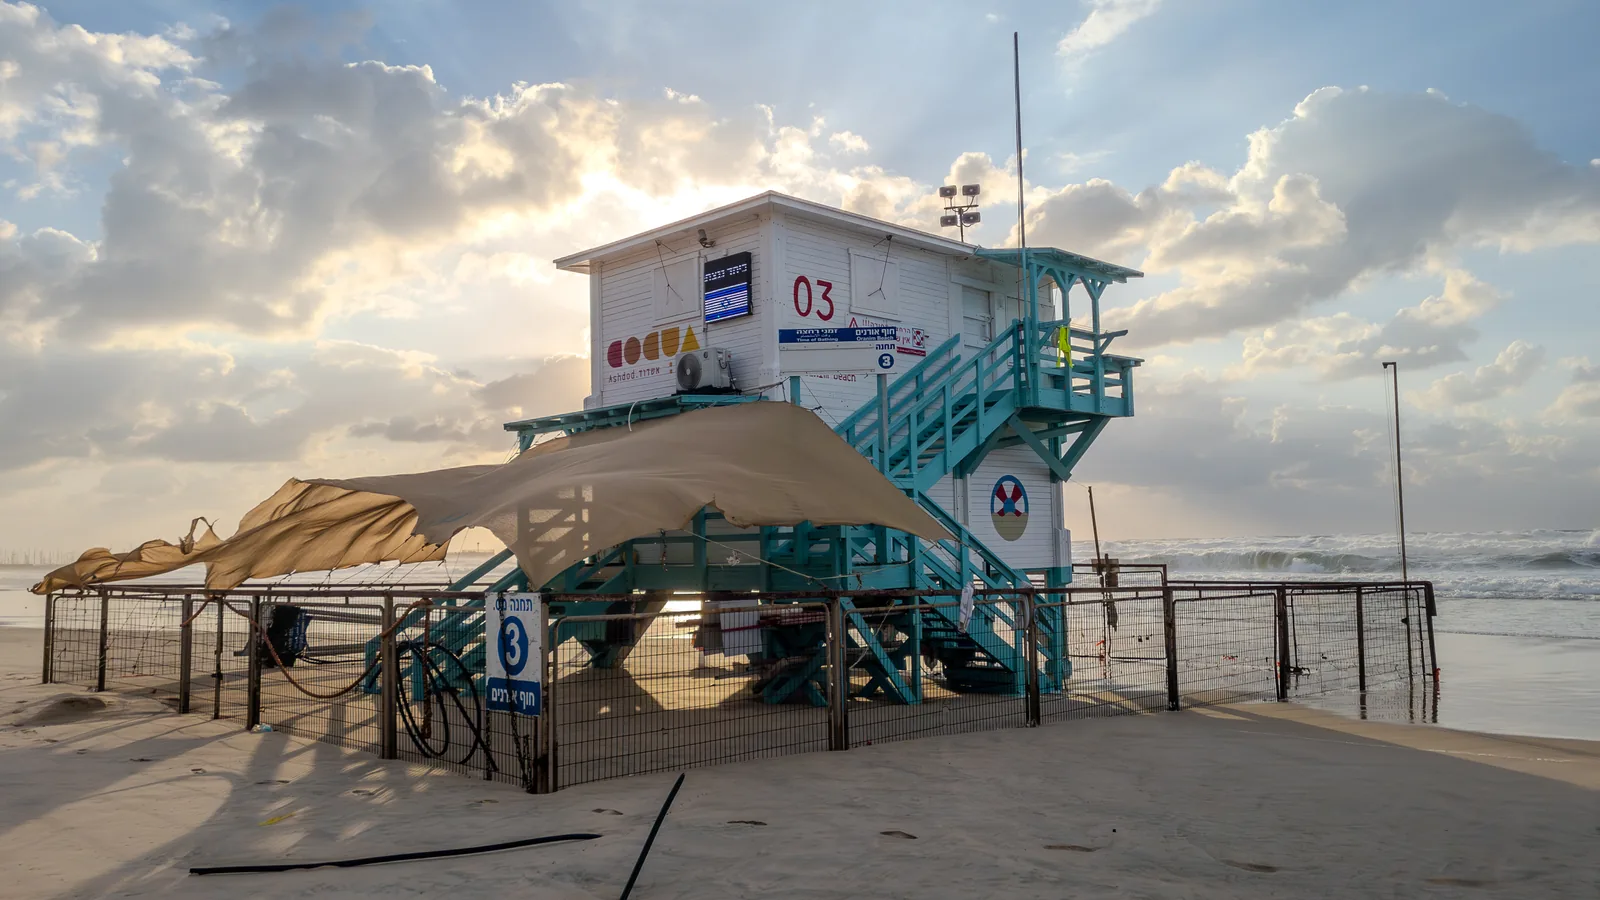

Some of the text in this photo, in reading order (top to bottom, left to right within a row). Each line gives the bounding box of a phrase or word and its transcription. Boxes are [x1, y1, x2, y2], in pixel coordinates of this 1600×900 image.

[793, 275, 835, 322] 03
[855, 328, 895, 337] חוף אורנים
[882, 355, 891, 367] 3
[510, 598, 533, 612] תחנה
[505, 622, 521, 666] 3
[491, 687, 535, 710] חוף ארנים
